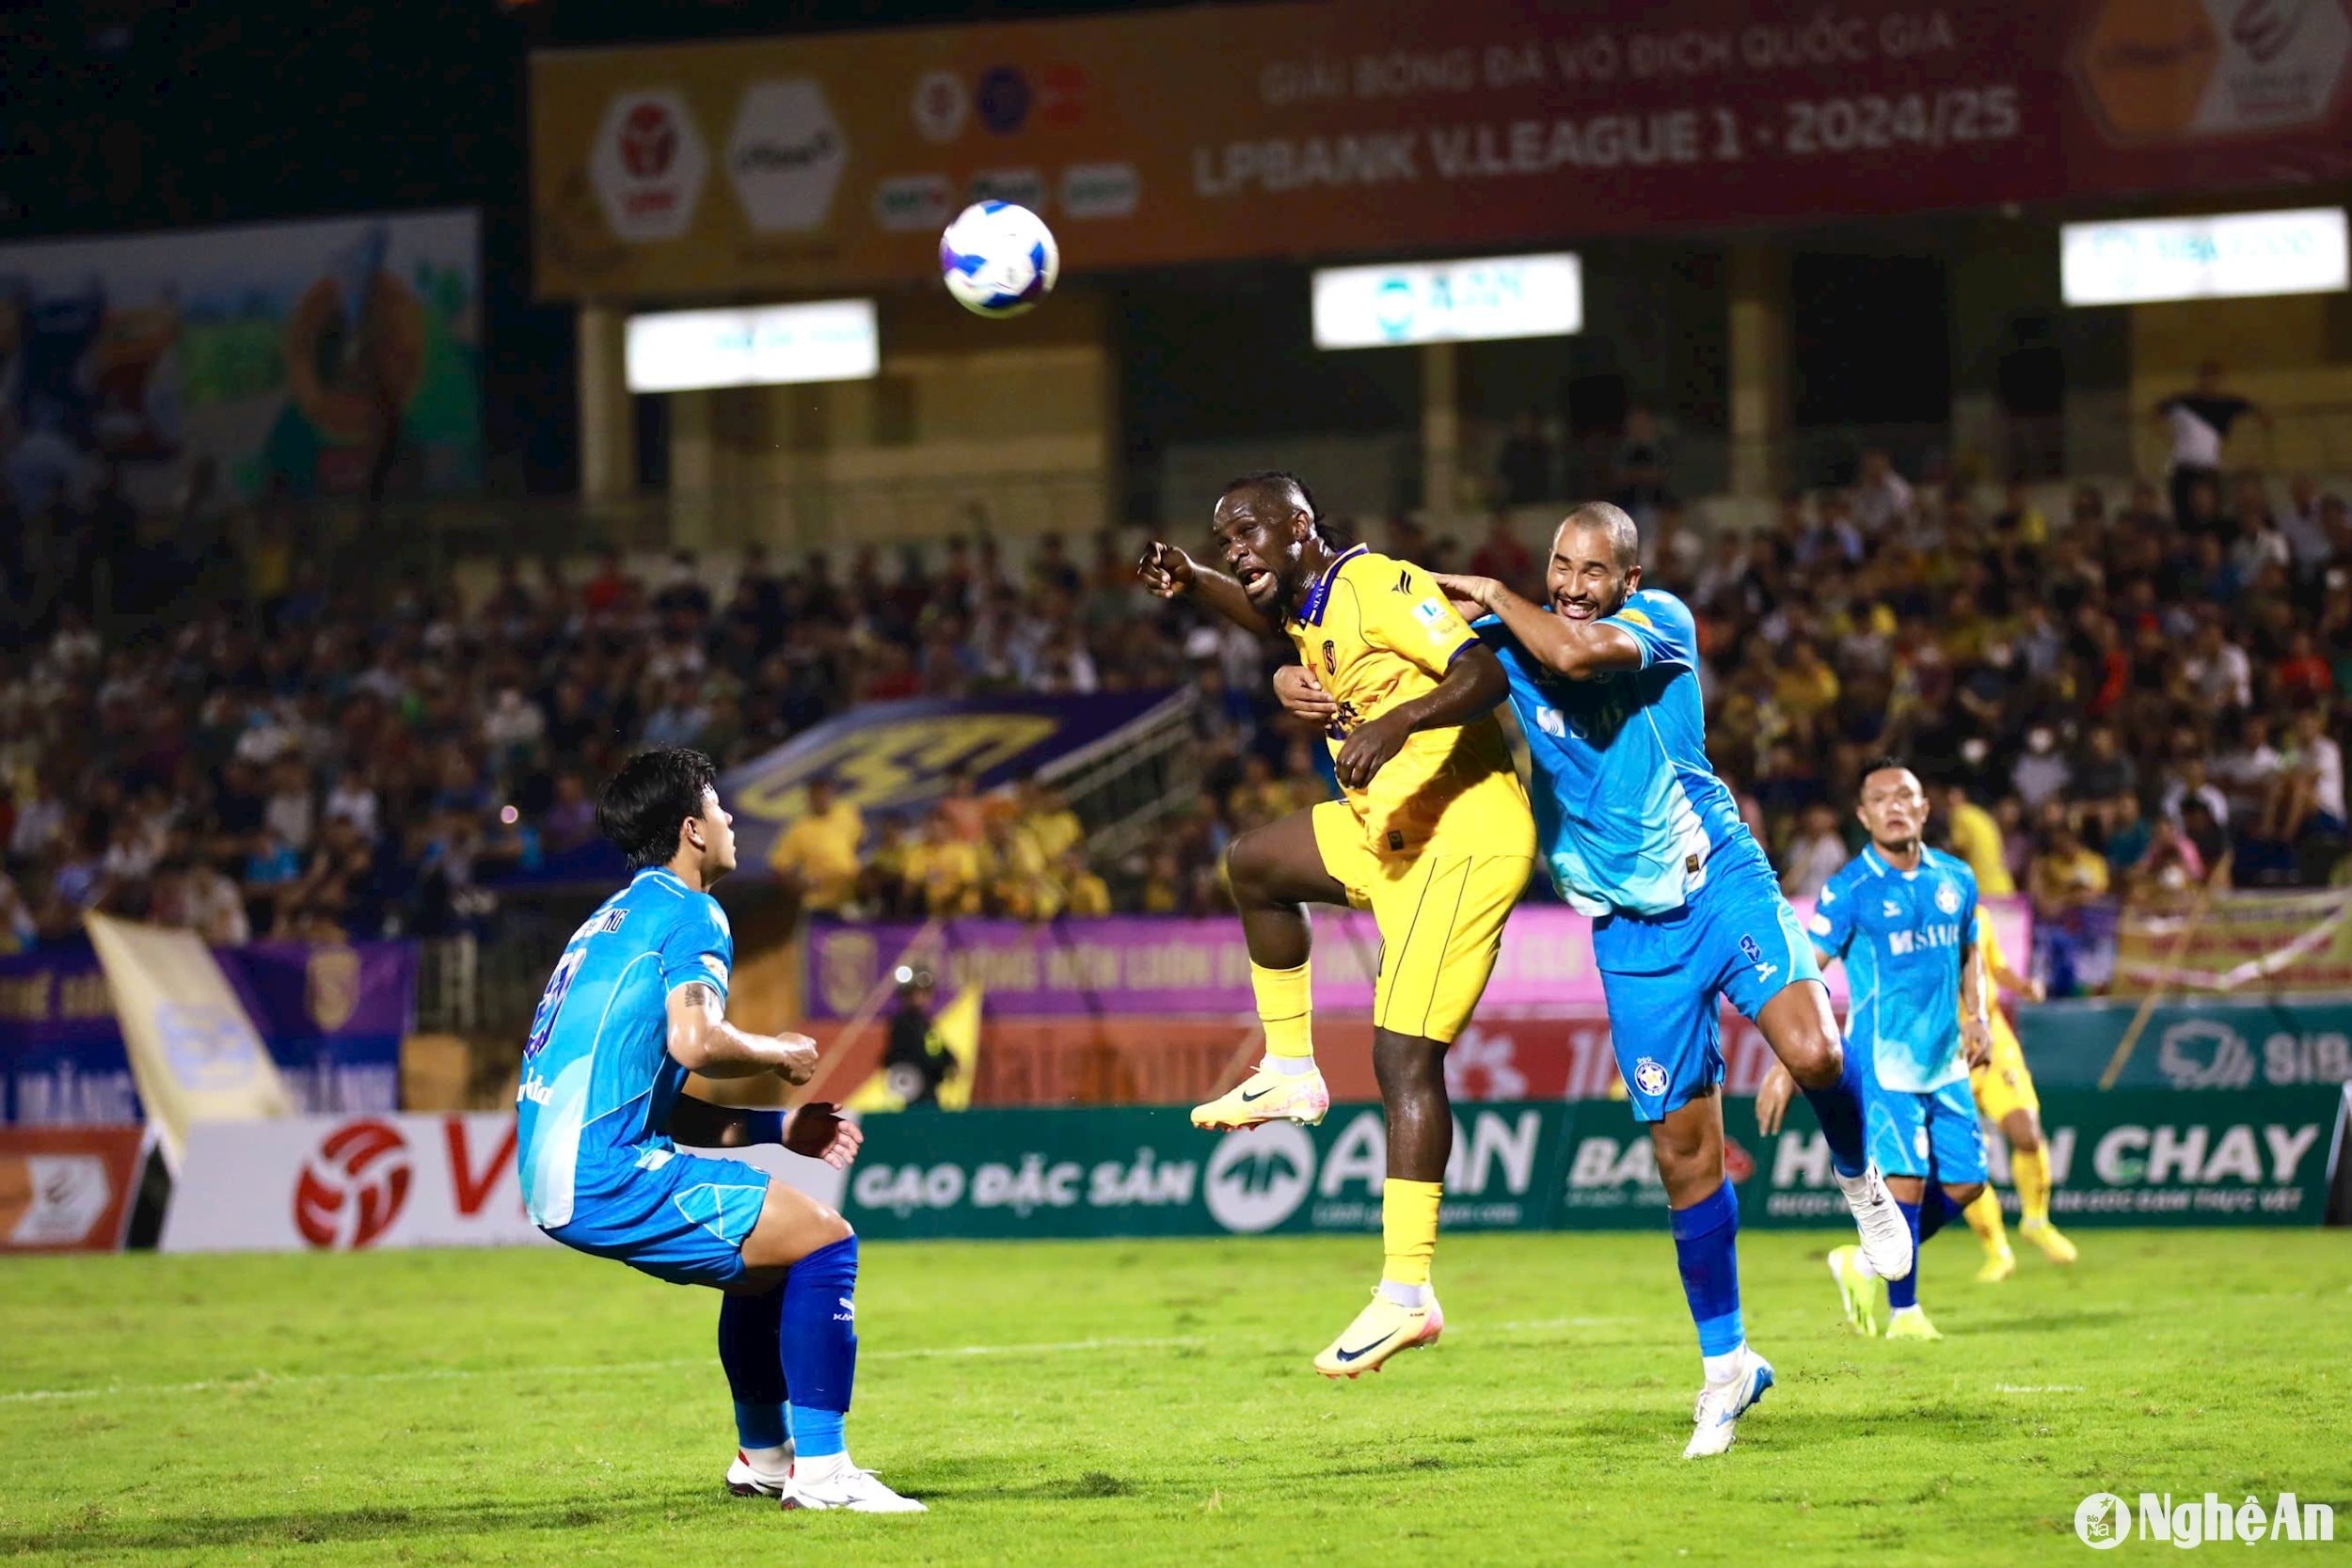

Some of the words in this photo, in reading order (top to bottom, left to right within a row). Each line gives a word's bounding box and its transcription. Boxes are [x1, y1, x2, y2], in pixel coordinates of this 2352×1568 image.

[1881, 9, 1958, 58] GIA
[1191, 132, 1418, 197] LPBANK
[1430, 110, 1699, 178] V.LEAGUE
[1712, 104, 1743, 160] 1
[1788, 84, 2022, 156] 2024/25
[853, 1163, 965, 1219] GẠO
[971, 1151, 1084, 1218] ĐẶC
[1089, 1146, 1199, 1206] SẢN
[2093, 1123, 2320, 1186] CHAY
